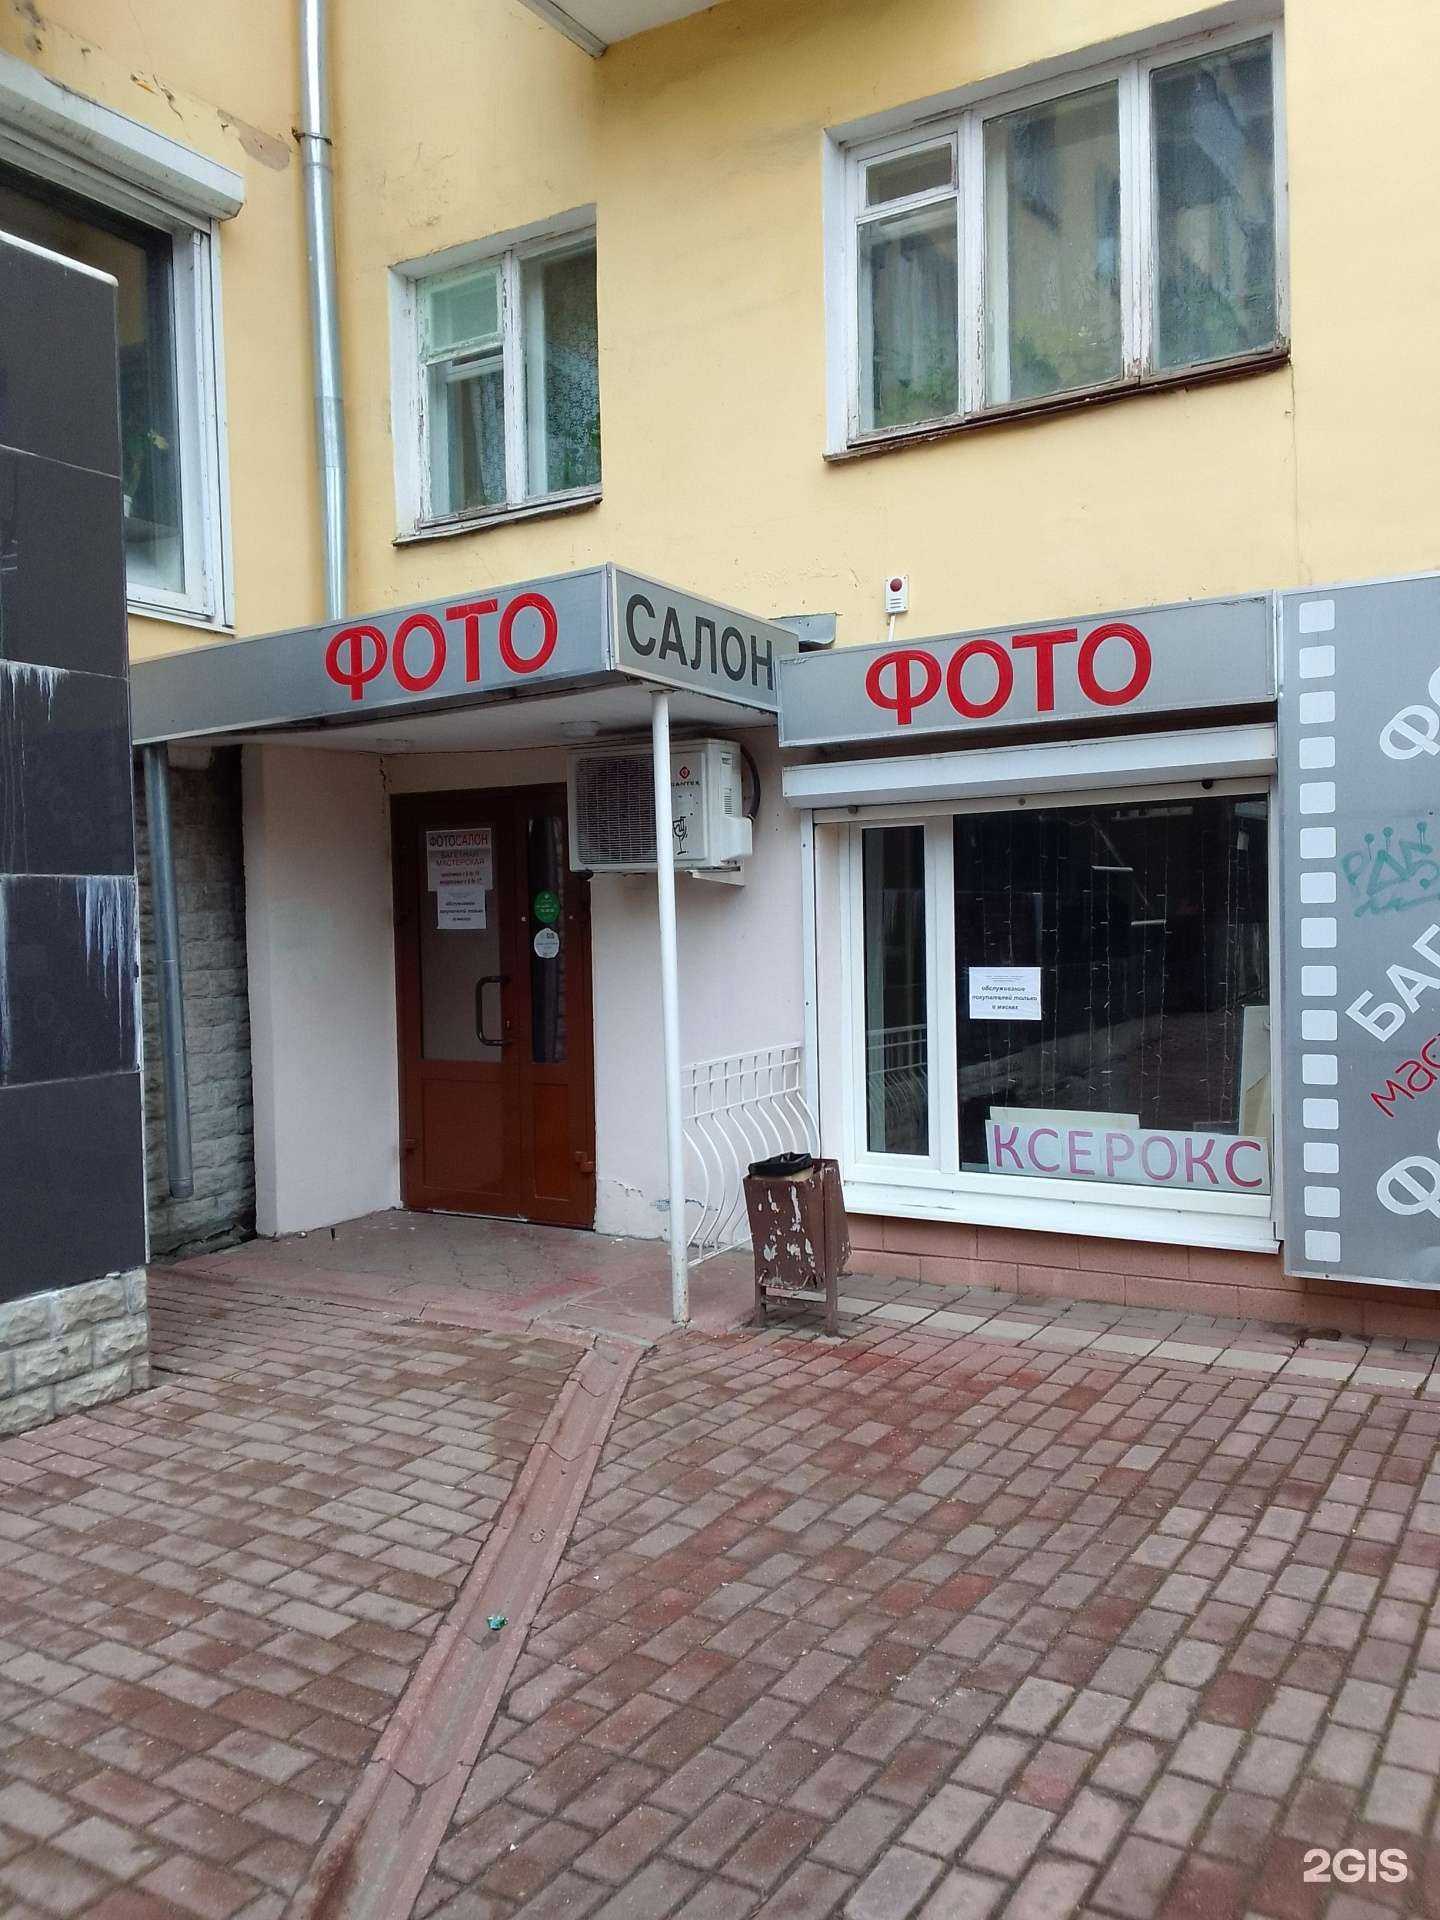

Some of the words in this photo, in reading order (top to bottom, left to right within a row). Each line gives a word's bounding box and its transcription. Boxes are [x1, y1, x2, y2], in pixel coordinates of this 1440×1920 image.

[326, 592, 558, 700] ФОТО
[626, 594, 773, 691] САЛОН
[865, 622, 1152, 725] ФОТО
[1379, 666, 1440, 760] Ф
[429, 833, 488, 848] ФОТОСАЛОН
[993, 1124, 1263, 1188] КСЕРОКС
